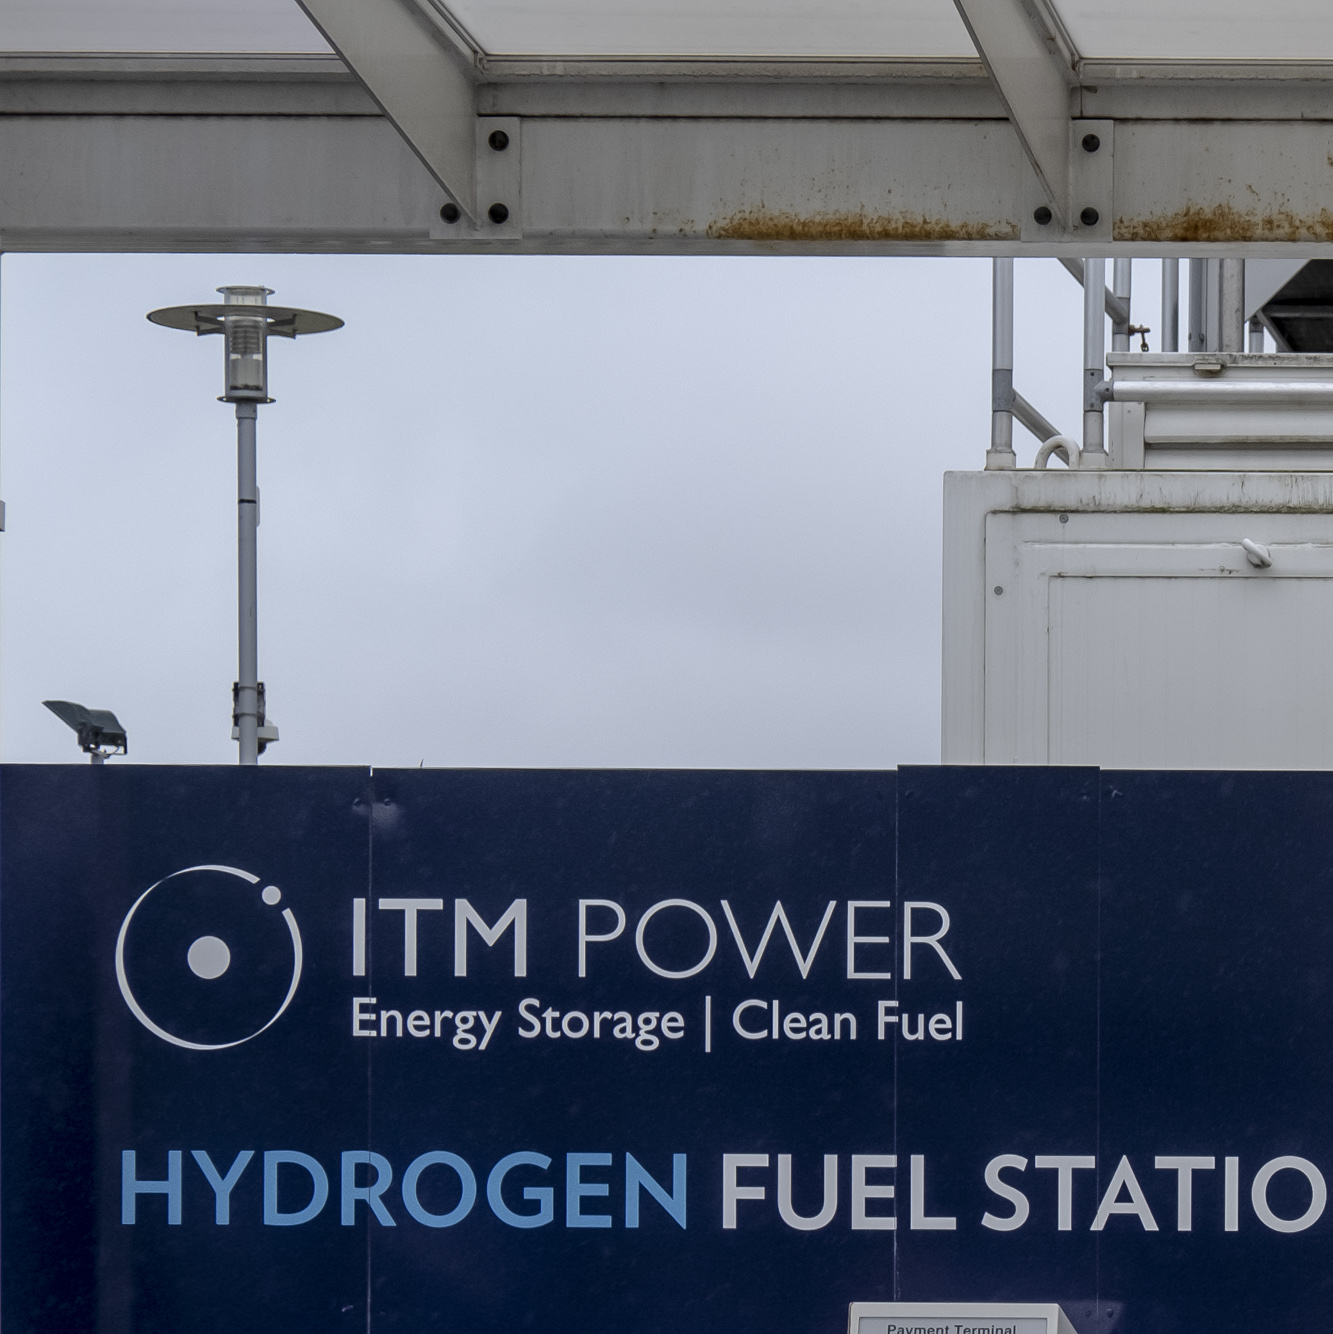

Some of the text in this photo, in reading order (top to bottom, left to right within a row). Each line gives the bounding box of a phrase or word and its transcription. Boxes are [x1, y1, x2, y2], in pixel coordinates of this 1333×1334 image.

[353, 898, 963, 980] ITM POWER
[352, 997, 963, 1051] Energy Storage Clean Fuel
[121, 1149, 688, 1230] HYDROGEN
[722, 1153, 957, 1231] FUEL
